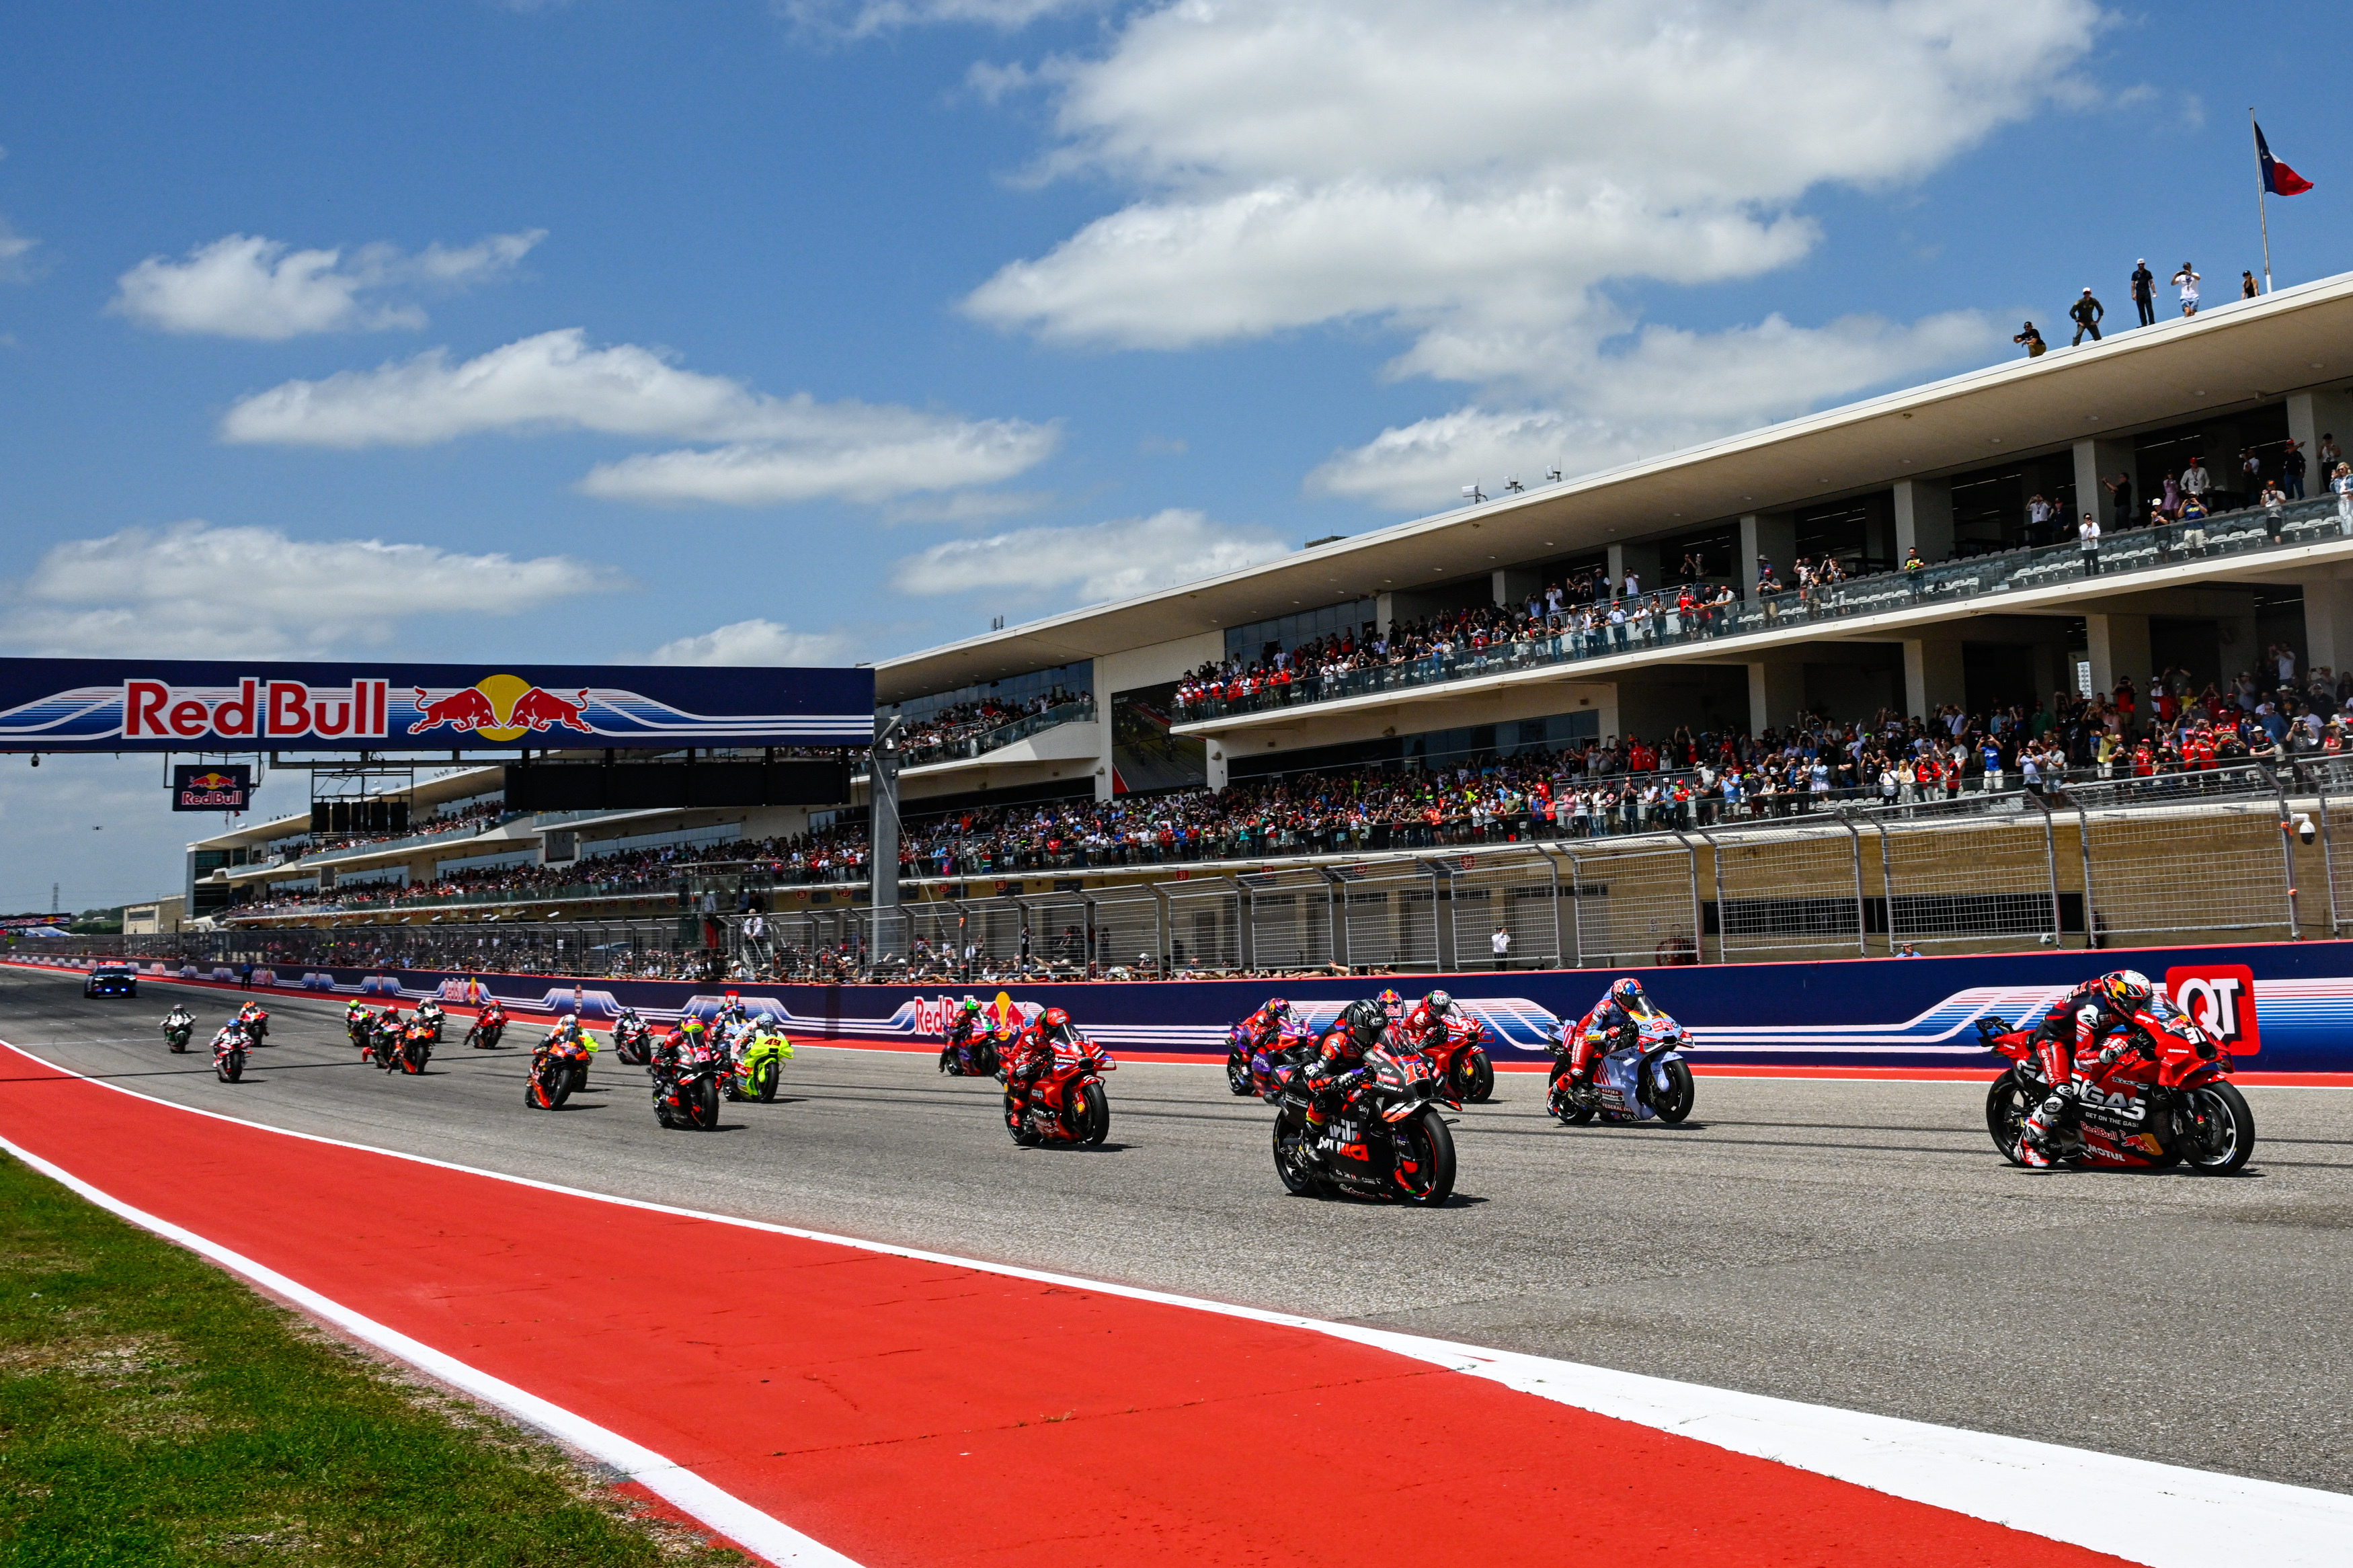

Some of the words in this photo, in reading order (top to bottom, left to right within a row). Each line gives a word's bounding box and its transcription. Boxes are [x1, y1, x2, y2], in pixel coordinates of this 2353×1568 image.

[126, 680, 255, 735] Red
[269, 681, 386, 735] Bull
[182, 791, 212, 805] Red
[212, 790, 243, 805] Bull
[1179, 872, 1186, 880] 31
[2177, 978, 2239, 1041] QT
[1651, 1020, 1674, 1033] 93
[764, 1038, 782, 1046] 49
[2184, 1027, 2206, 1044] 31
[1253, 1055, 1269, 1067] prima
[1358, 1104, 1369, 1114] sky
[1602, 1103, 1623, 1111] FEDERAL
[2109, 1116, 2121, 1124] THE
[2122, 1120, 2139, 1128] GAS!
[2081, 1120, 2100, 1136] Red
[2098, 1127, 2118, 1141] Bull
[2088, 1143, 2126, 1162] MOTUL
